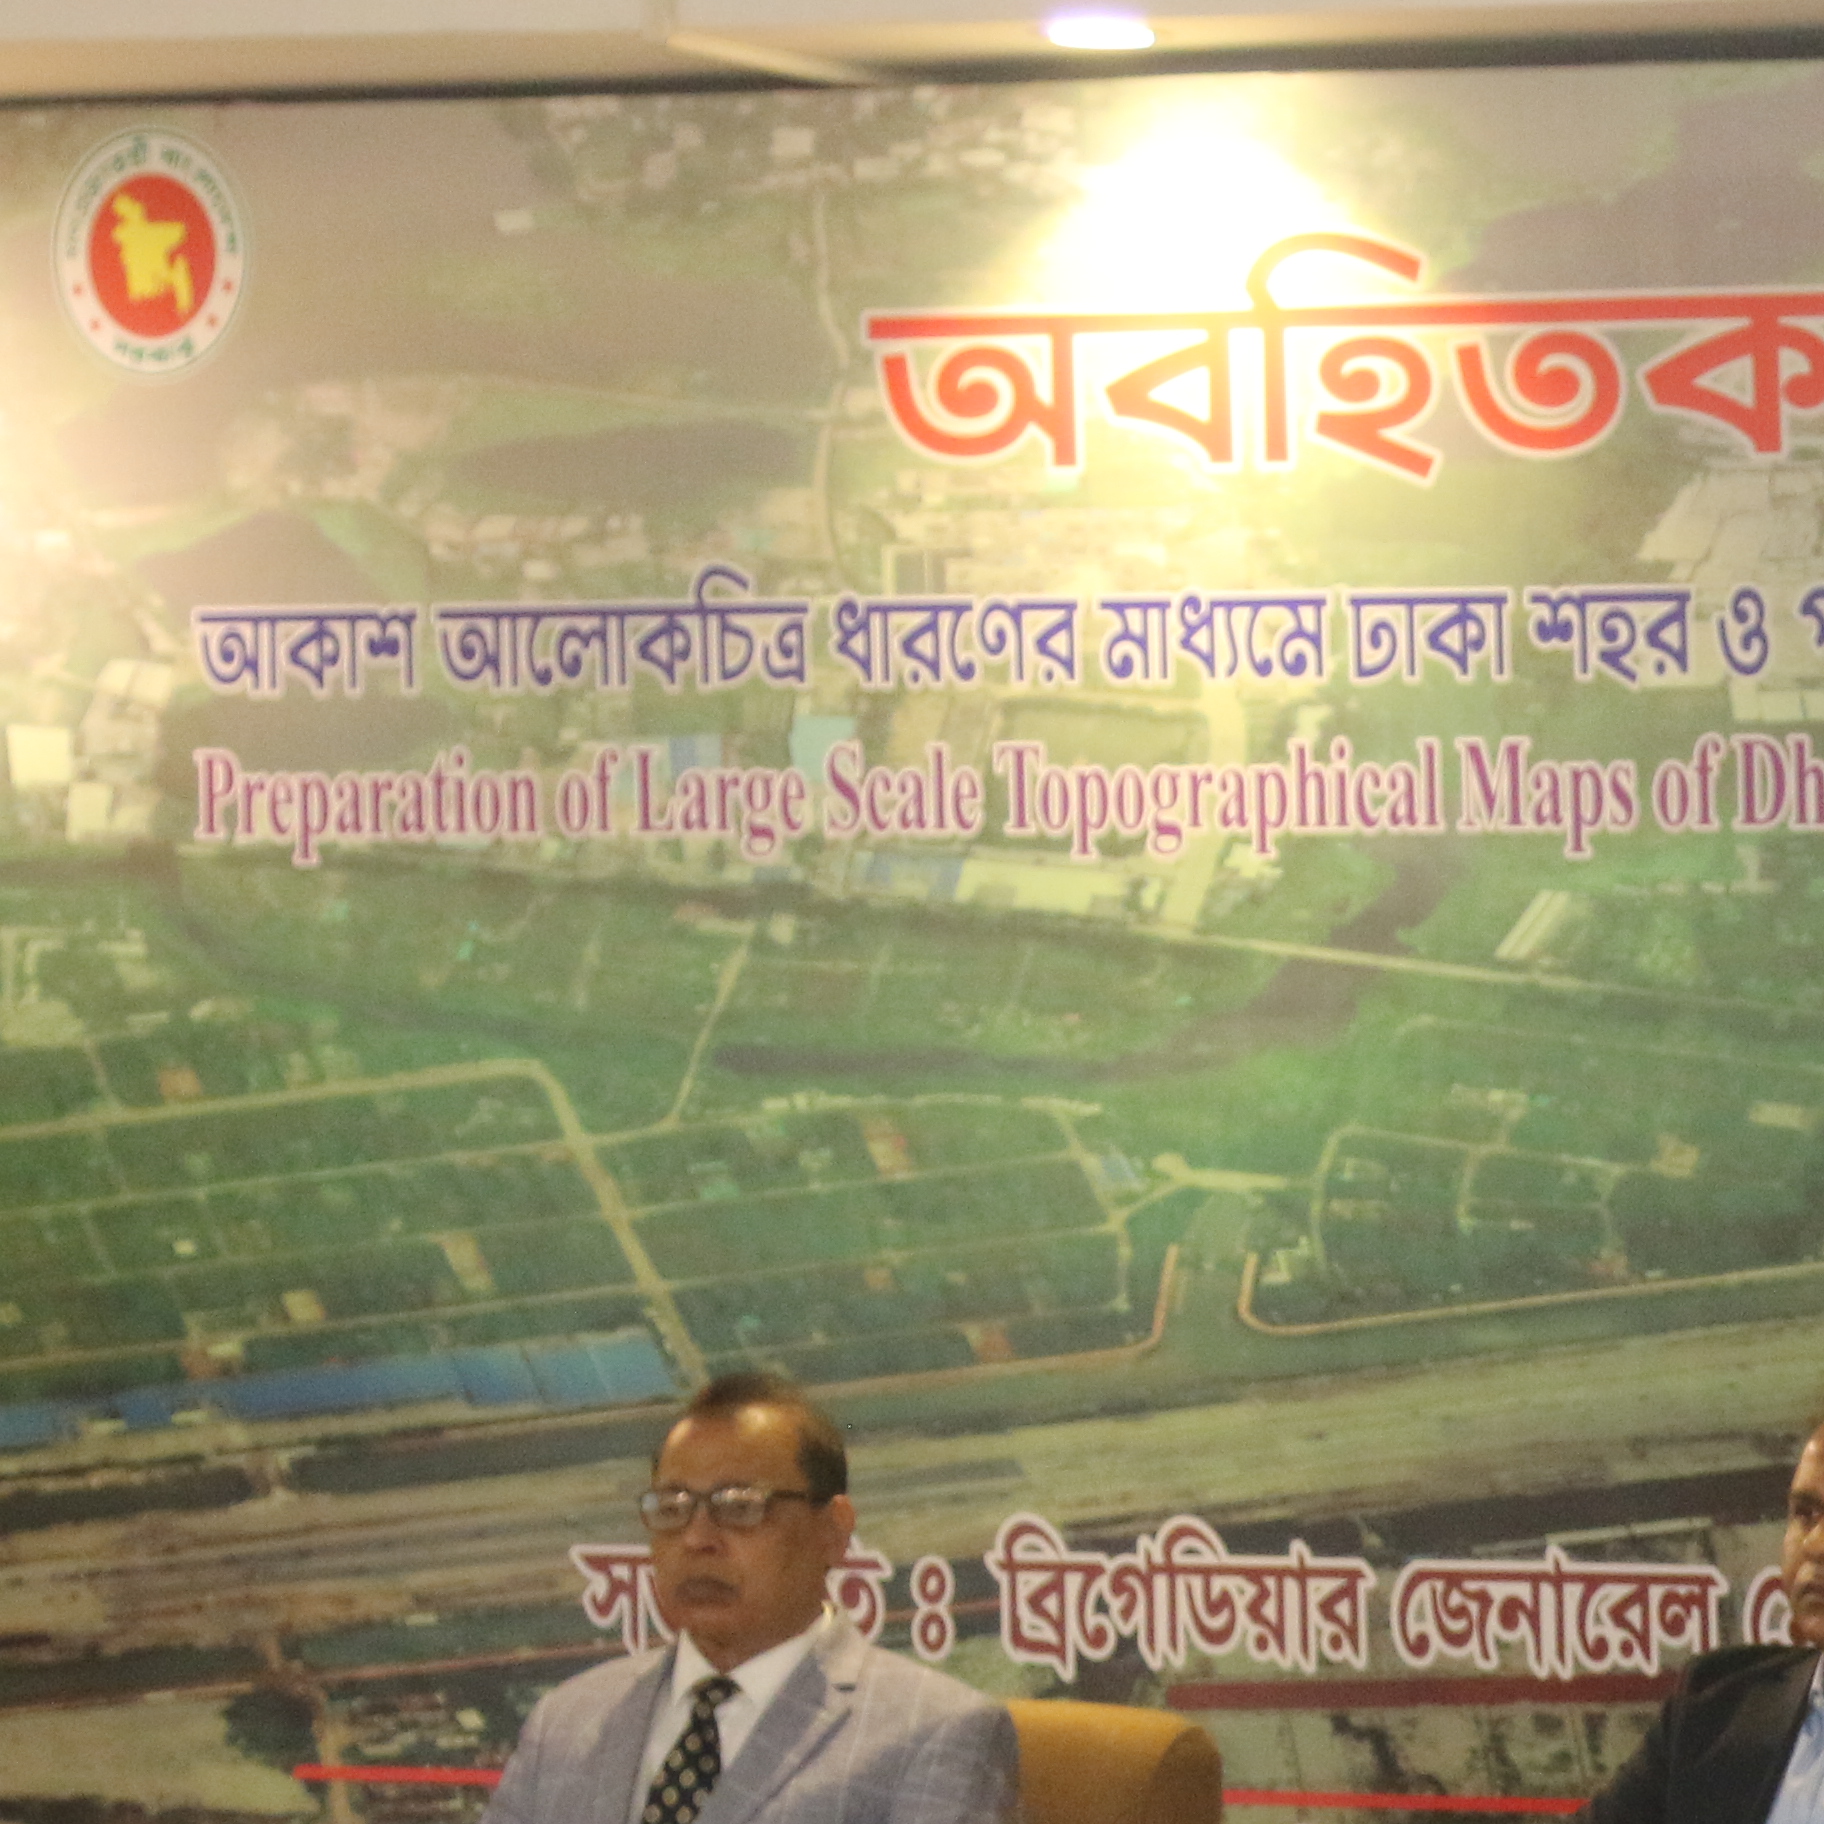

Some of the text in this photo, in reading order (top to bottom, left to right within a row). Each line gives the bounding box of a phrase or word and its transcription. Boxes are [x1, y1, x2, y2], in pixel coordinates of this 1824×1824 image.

[198, 609, 417, 691] আকাশ
[437, 563, 810, 687] আলোকচিত্র
[832, 594, 1079, 684] ধারণের
[1097, 593, 1328, 680] মাধ্যমে
[1348, 594, 1509, 678] ঢাকা
[1528, 589, 1692, 684] শহর
[1718, 586, 1769, 677] ও
[198, 750, 541, 862] Preparation
[557, 748, 619, 834] of
[635, 748, 807, 856] Large
[825, 744, 982, 833] Scale
[998, 740, 1441, 855] Topographical
[1461, 738, 1636, 855] Maps
[1653, 736, 1723, 828] of
[993, 1518, 1370, 1673] ব্রিগেডিয়ার
[1399, 1555, 1722, 1671] জেনারেল
